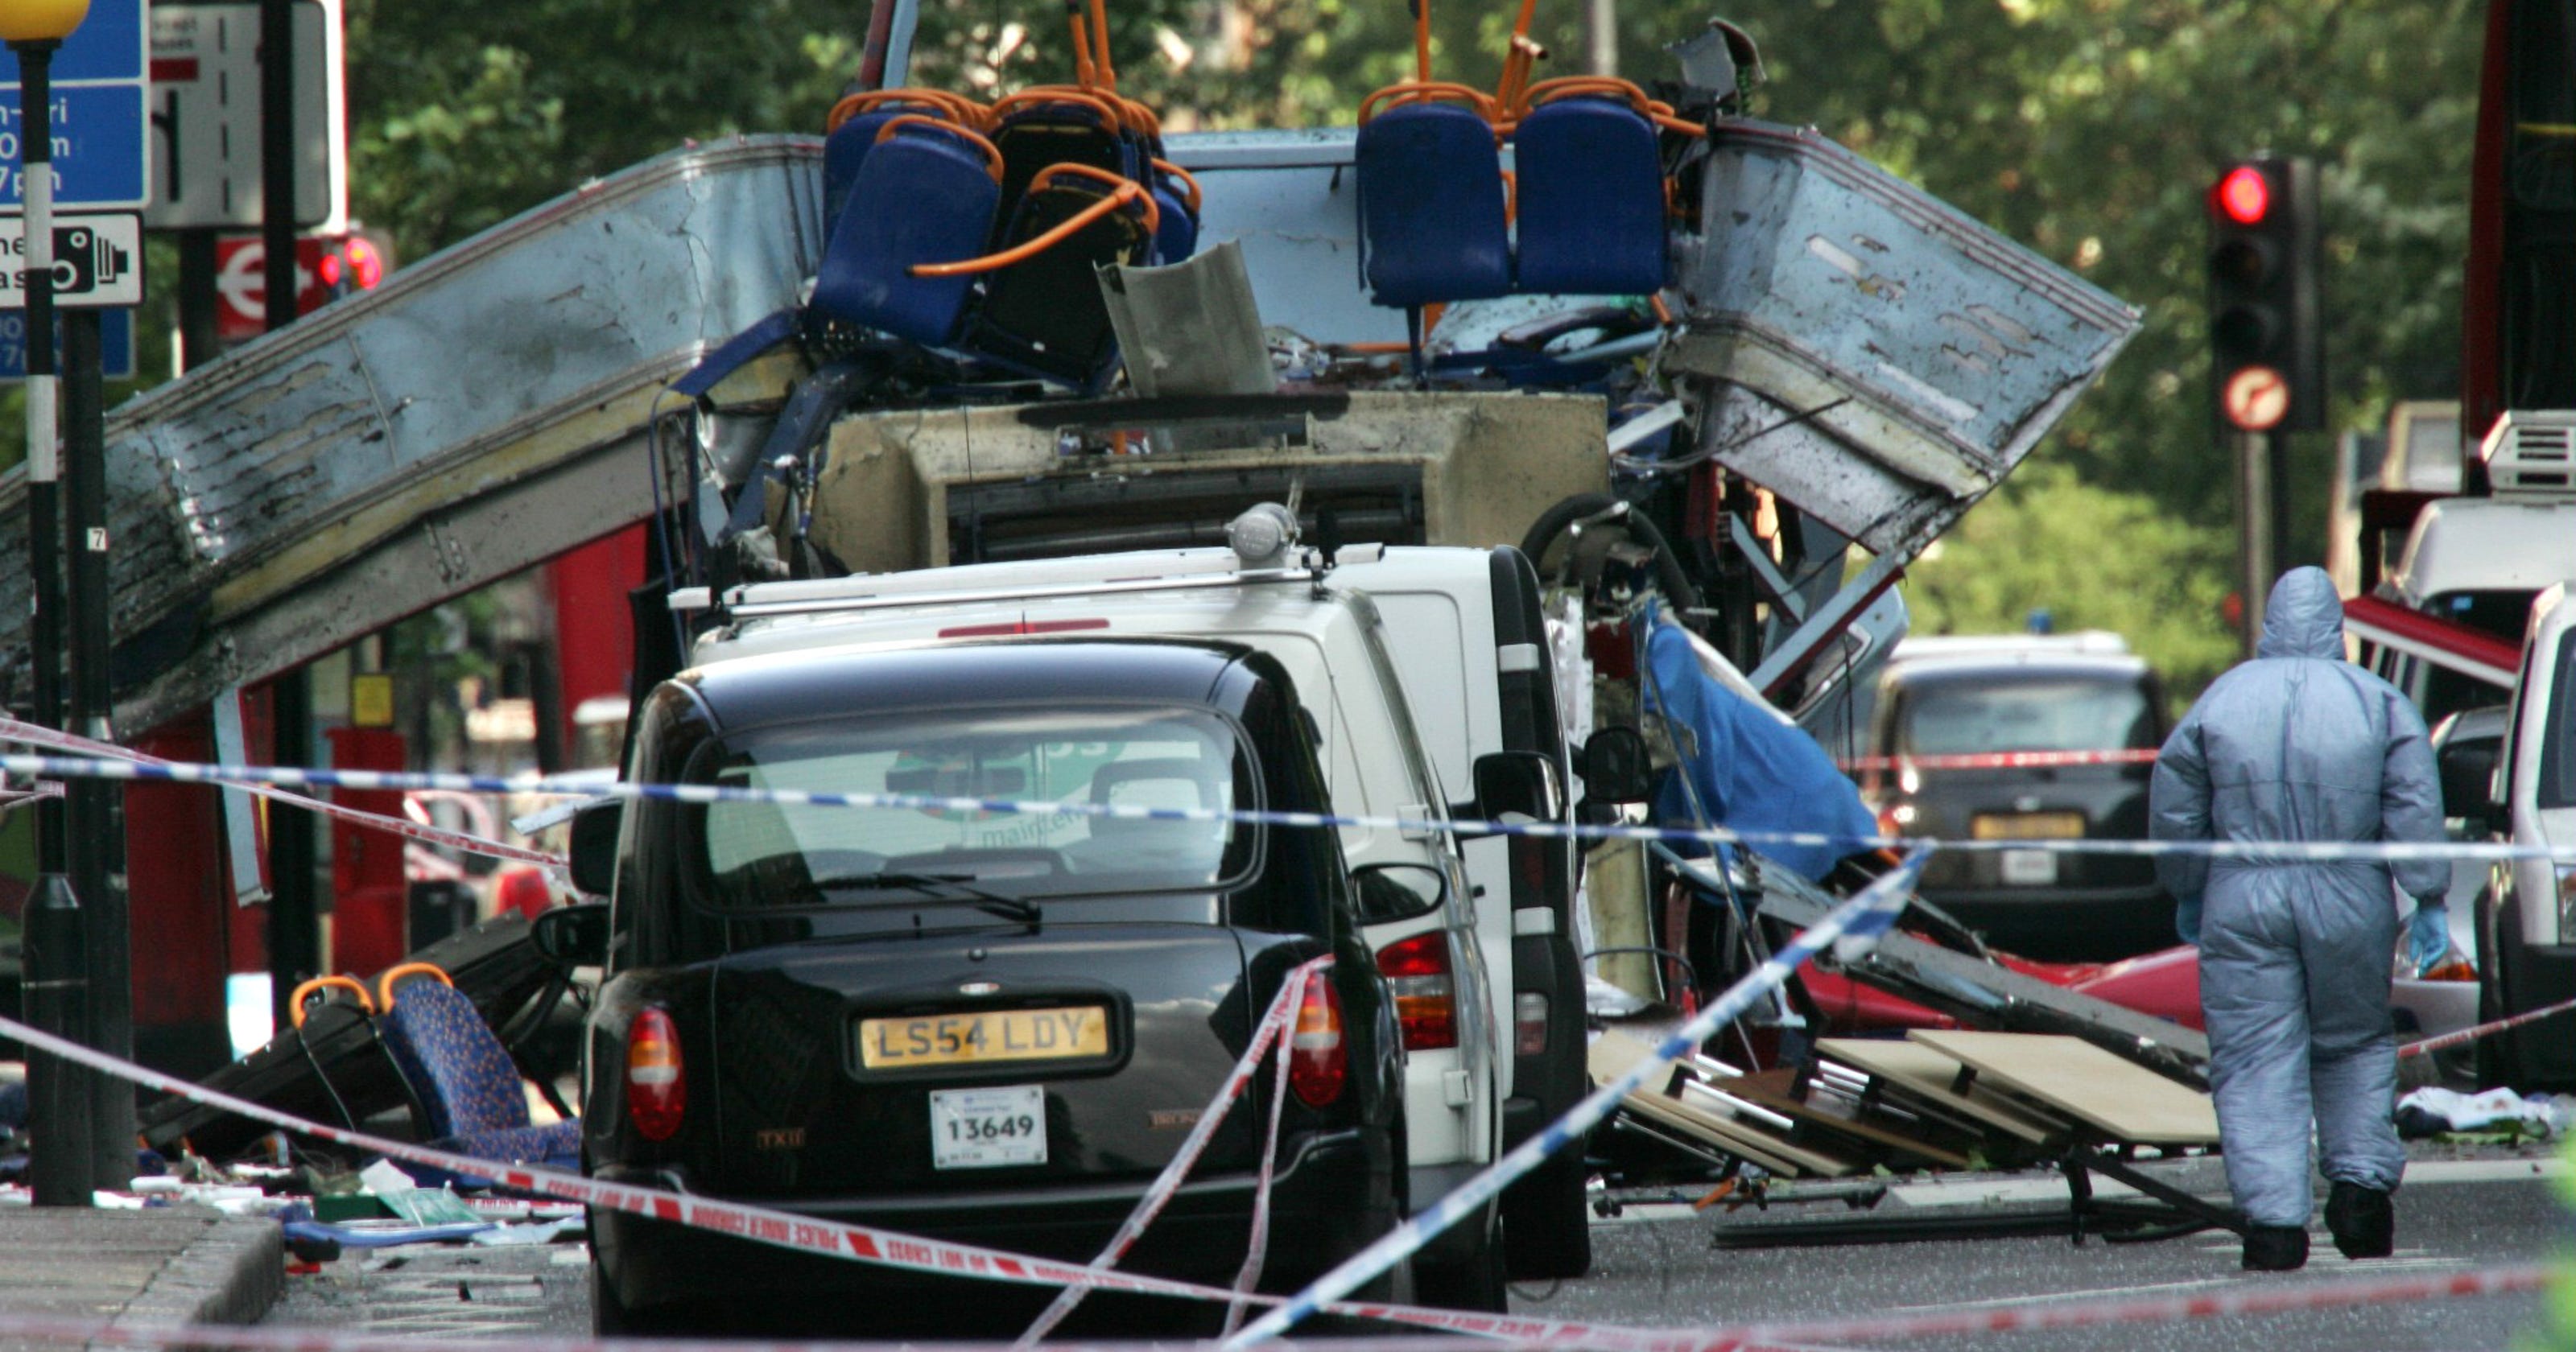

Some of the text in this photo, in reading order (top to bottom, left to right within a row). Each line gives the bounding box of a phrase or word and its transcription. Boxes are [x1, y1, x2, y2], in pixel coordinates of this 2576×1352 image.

[93, 530, 104, 547] 7
[877, 1011, 1084, 1058] LS54 LDY
[948, 1115, 1034, 1141] 13649
